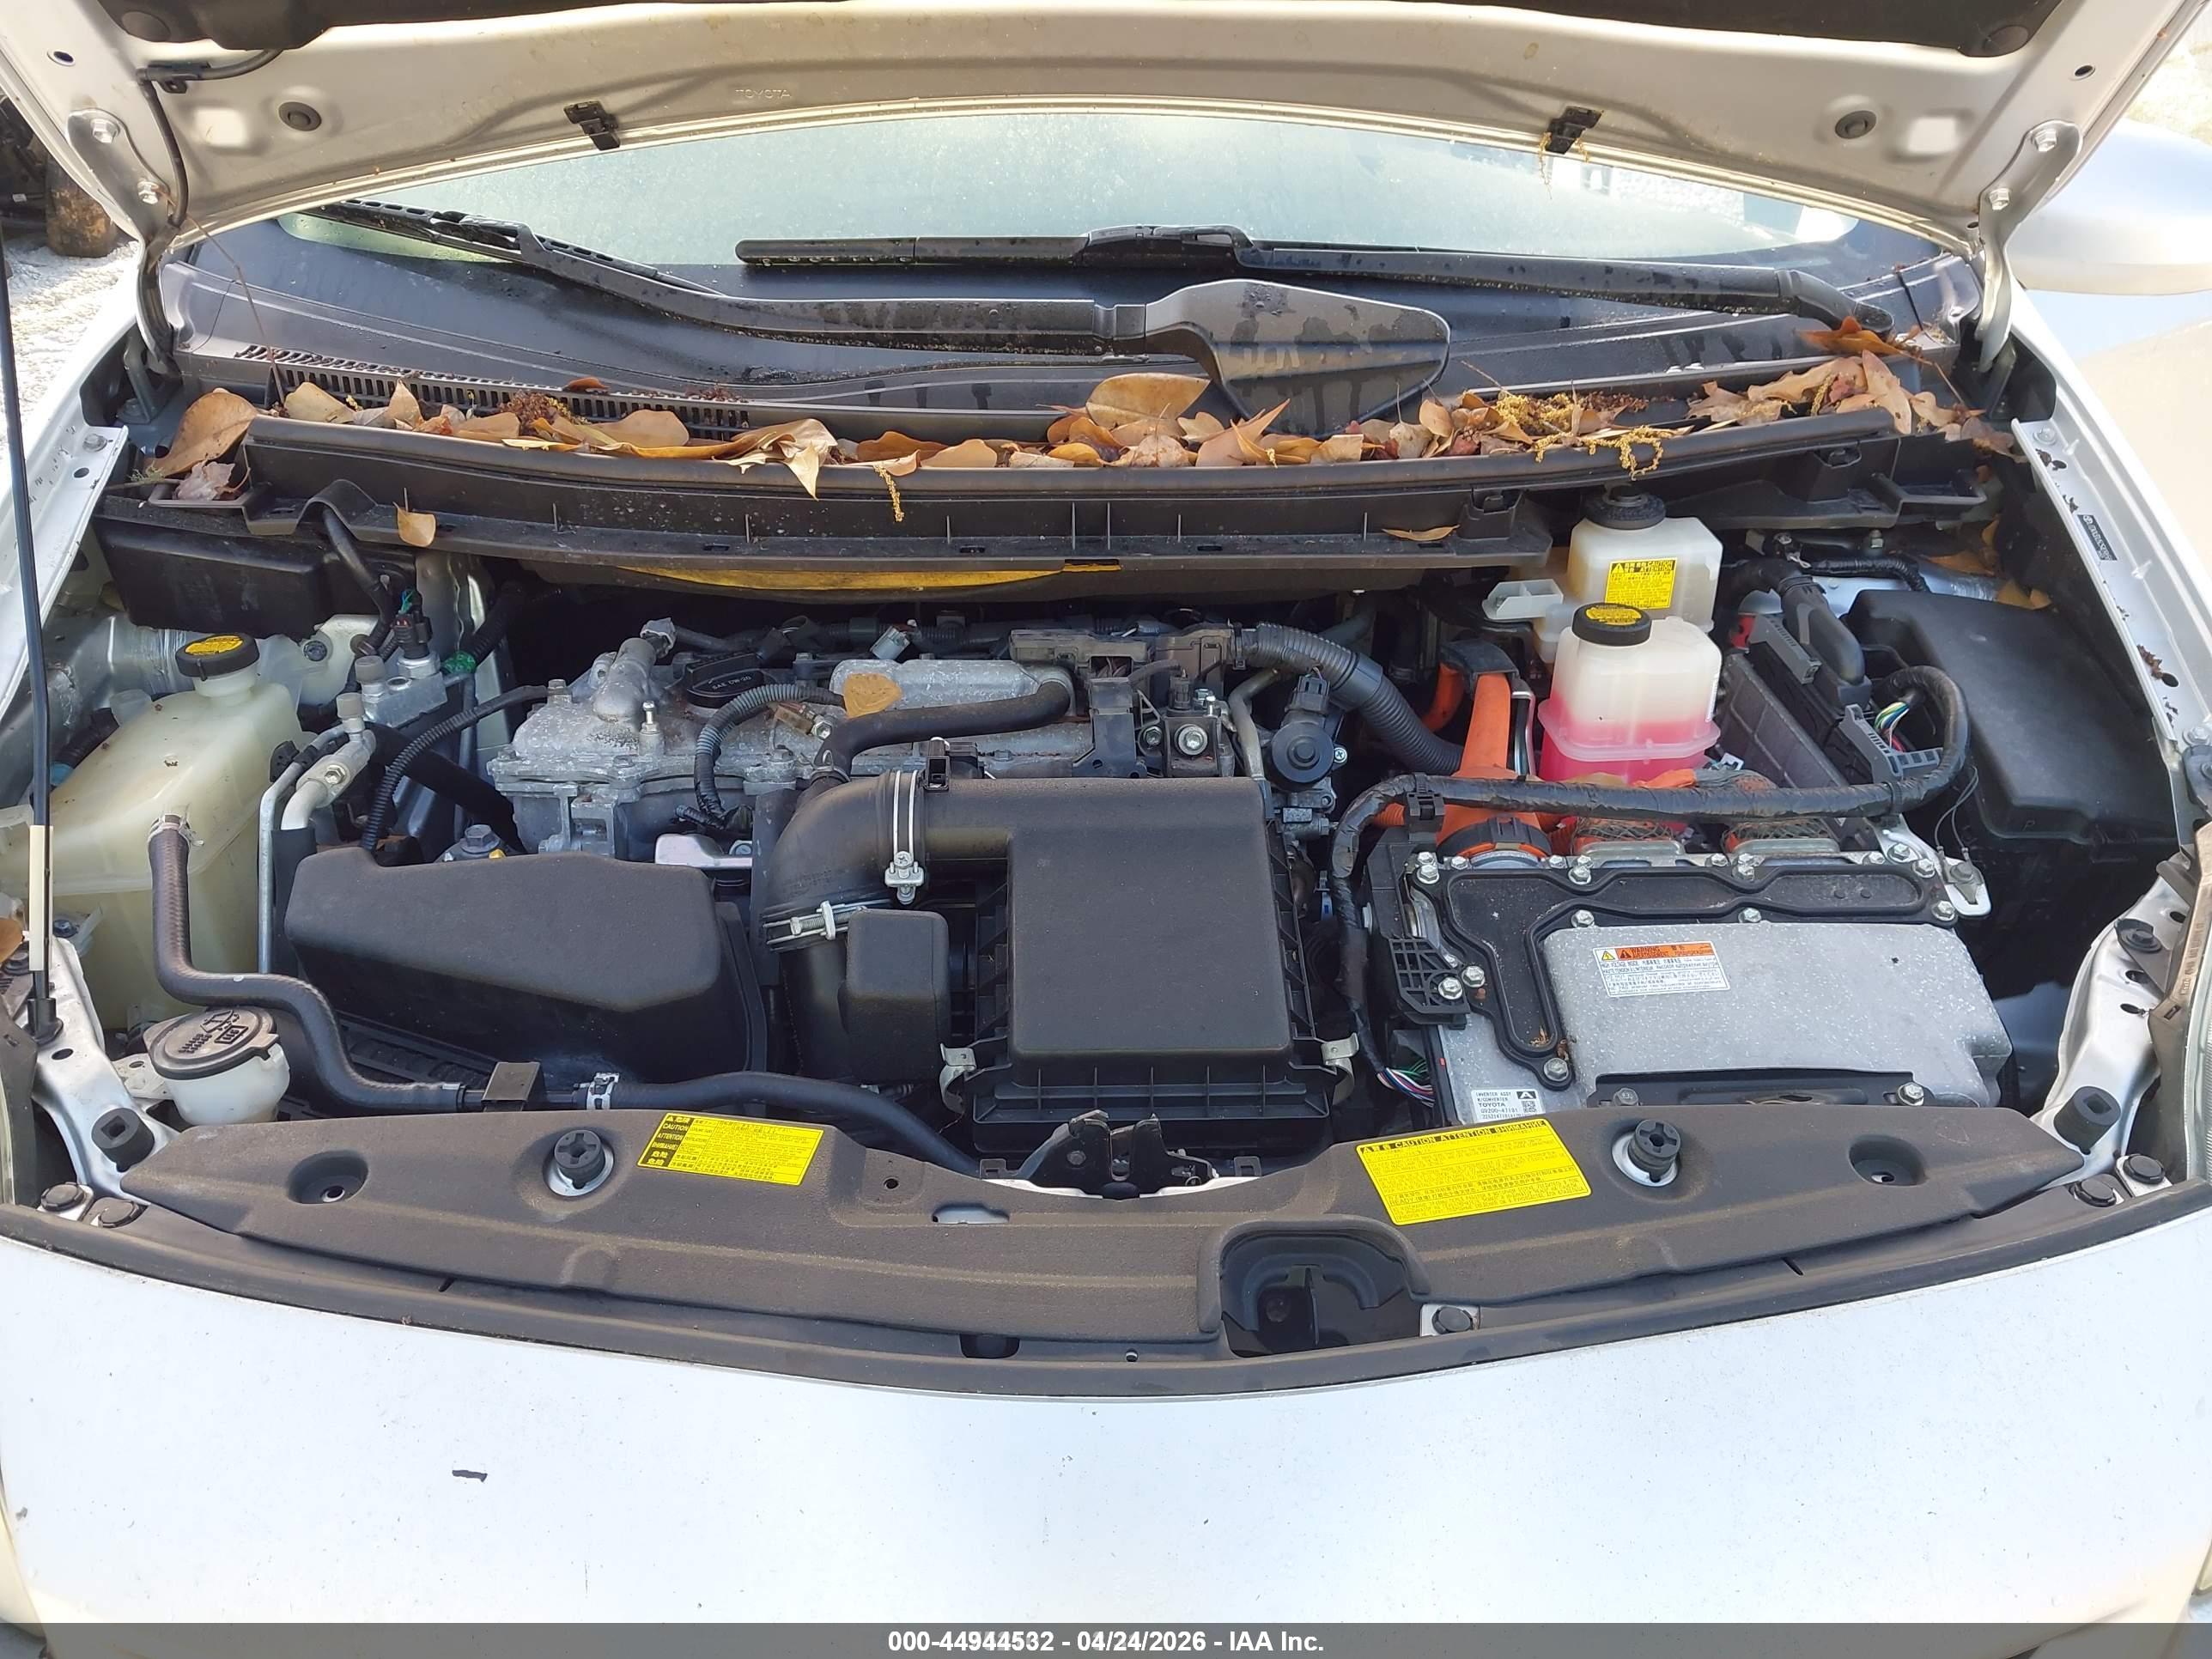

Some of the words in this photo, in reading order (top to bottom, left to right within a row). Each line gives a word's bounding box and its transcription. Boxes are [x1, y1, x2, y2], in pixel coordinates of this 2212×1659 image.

[735, 88, 792, 100] TOYOTA
[662, 1122, 690, 1132] CAUTION
[657, 1132, 684, 1141] ATTENTION
[1395, 1136, 1436, 1148] CAUTION
[1440, 1127, 1491, 1142] ATTENTION
